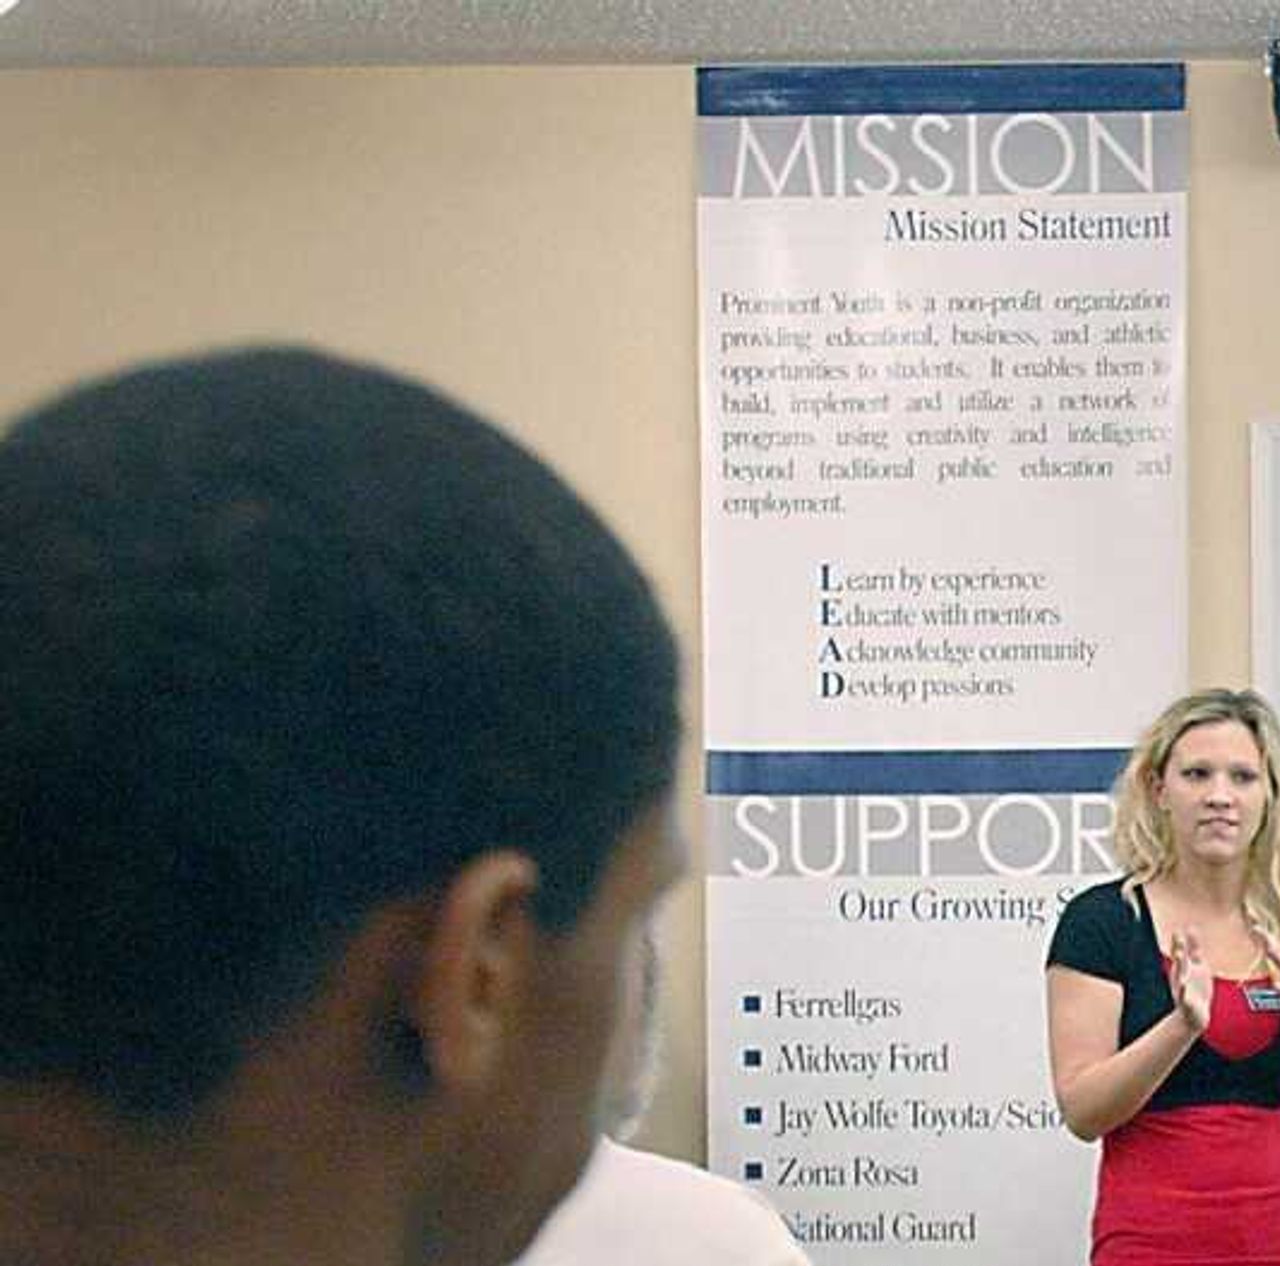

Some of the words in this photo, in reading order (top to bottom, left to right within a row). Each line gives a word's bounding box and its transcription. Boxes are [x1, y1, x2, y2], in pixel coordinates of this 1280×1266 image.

[734, 112, 1154, 198] MISSION
[884, 208, 1008, 243] Mission
[1018, 208, 1172, 242] Statement
[720, 291, 820, 314] Prominent
[948, 290, 1042, 318] non-profit
[1054, 289, 1171, 316] organization
[720, 327, 812, 352] providing
[825, 325, 940, 347] educational,
[952, 324, 1042, 347] business,
[1052, 323, 1089, 345] and
[1104, 321, 1172, 345] athletic
[720, 358, 850, 385] opportunities
[858, 361, 878, 378] to
[990, 355, 1003, 378] It
[1012, 354, 1087, 378] enables
[1095, 354, 1144, 377] them
[721, 391, 776, 416] build,
[791, 390, 889, 422] implement
[904, 389, 942, 413] and
[959, 390, 1014, 412] utilize
[1058, 387, 1137, 411] network
[721, 431, 816, 452] programs
[836, 427, 889, 451] using
[905, 423, 990, 451] creativity
[1009, 422, 1048, 444] and
[722, 457, 794, 482] beyond
[819, 457, 914, 480] traditional
[937, 455, 998, 484] public
[1019, 456, 1114, 479] education
[1134, 453, 1172, 477] and
[722, 491, 846, 519] employment.
[900, 567, 925, 597] by
[931, 568, 1046, 597] experience
[921, 602, 968, 627] with
[973, 604, 1062, 627] mentors
[979, 636, 1099, 668] community
[921, 671, 1015, 702] passions
[730, 793, 1122, 878] SUPPOR
[839, 888, 900, 921] Our
[911, 887, 1046, 925] Growing
[775, 986, 902, 1022] Ferrellgas
[775, 1042, 883, 1080] Midway
[889, 1042, 950, 1074] Ford
[773, 1099, 818, 1138] Jay
[824, 1099, 899, 1129] Wolfe
[904, 1099, 1065, 1137] Toyota/Scio
[776, 1156, 846, 1187] Zona
[853, 1156, 919, 1187] Rosa
[892, 1211, 976, 1243] Guard
